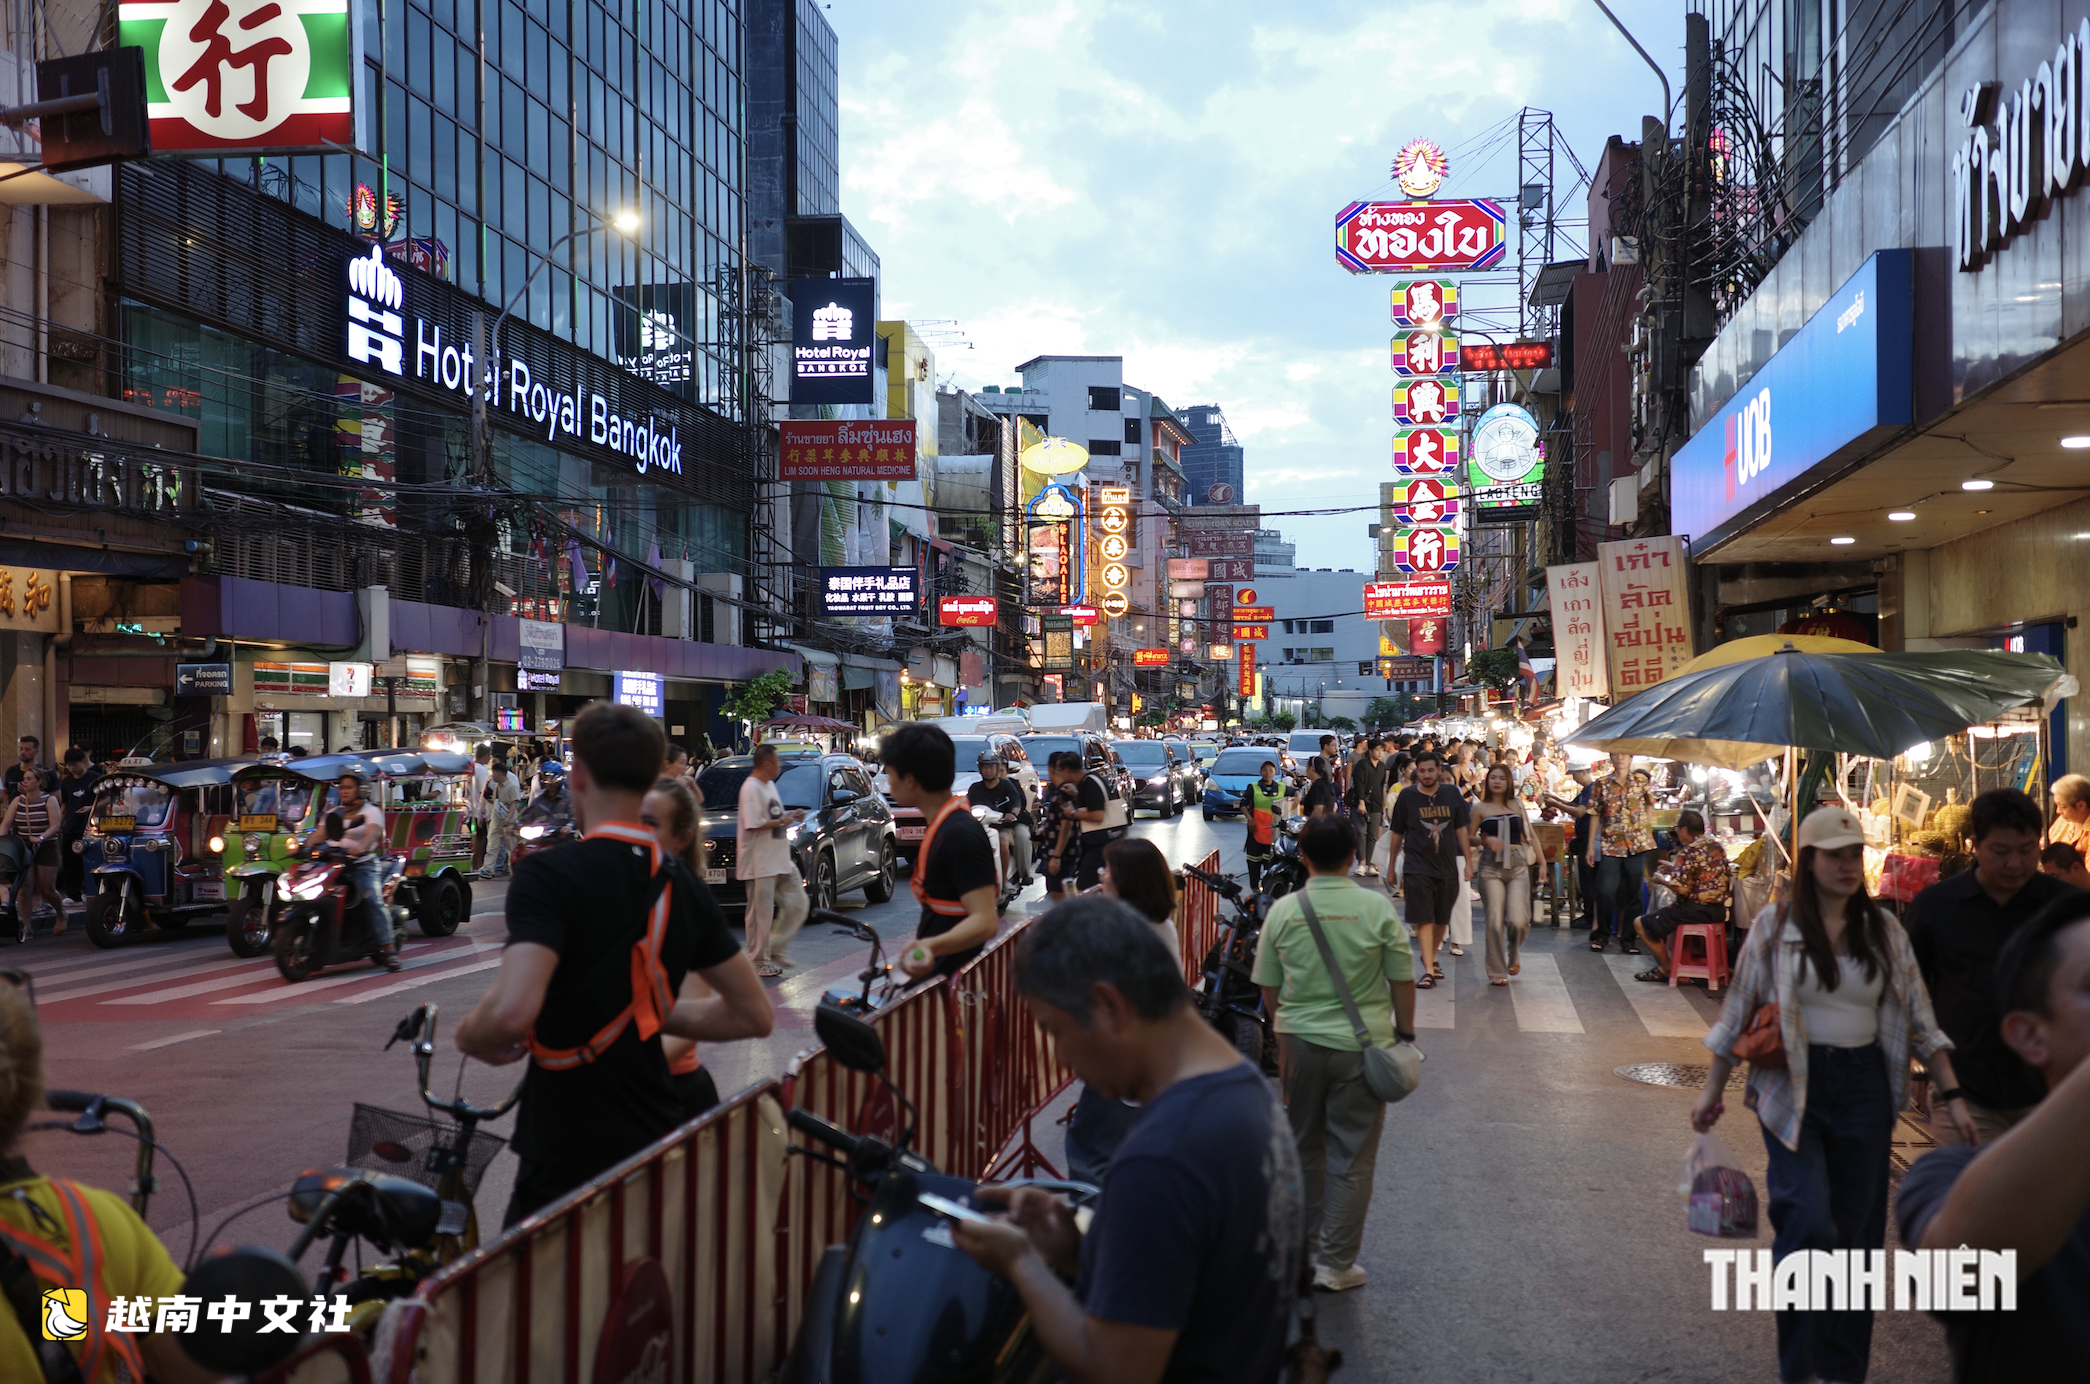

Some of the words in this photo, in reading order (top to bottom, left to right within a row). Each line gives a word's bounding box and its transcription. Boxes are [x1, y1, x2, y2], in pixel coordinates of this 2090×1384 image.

[172, 0, 293, 122] 行
[1953, 16, 2090, 272] ห้างขาย
[1359, 208, 1425, 227] ห้างทอง
[795, 346, 831, 359] Hotel
[832, 346, 870, 361] Royal
[797, 364, 867, 373] BANGKOK
[511, 359, 583, 441] Royal
[591, 394, 683, 475] Bangkok
[785, 431, 834, 444] ร้านขายยา
[838, 422, 912, 451] ลิ้มซุ่นเฮง
[1738, 387, 1772, 485] UOB
[784, 466, 796, 476] LIM
[798, 466, 819, 476] SOON
[820, 466, 840, 475] HENG
[842, 466, 875, 475] NATURAL
[876, 465, 911, 475] MEDICINE
[1479, 486, 1538, 500] LAOTENG
[531, 672, 545, 683] Hotel
[114, 817, 133, 827] 5272
[260, 816, 273, 824] 344
[708, 869, 726, 878] 4708
